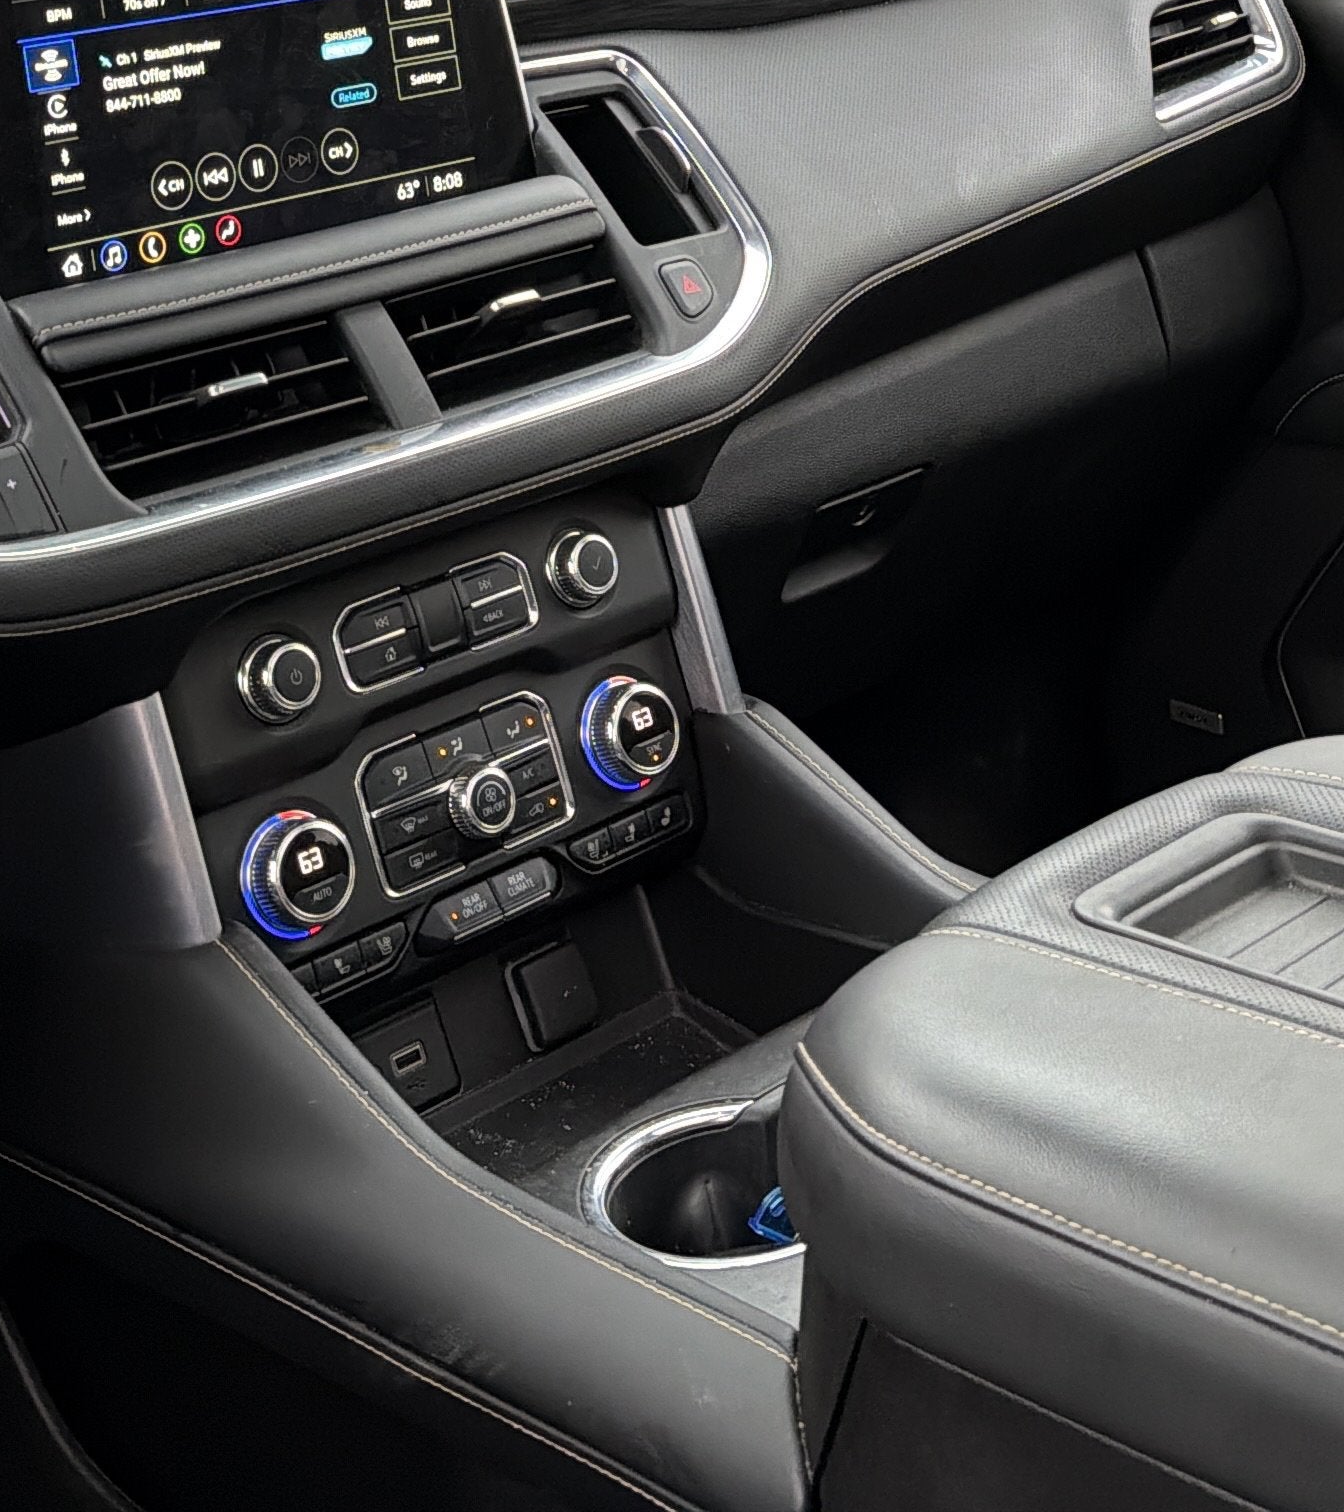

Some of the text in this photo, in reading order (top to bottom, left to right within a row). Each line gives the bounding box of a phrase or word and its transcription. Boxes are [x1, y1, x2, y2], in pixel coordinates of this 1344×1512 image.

[46, 7, 73, 23] BPM
[406, 34, 440, 49] Browse
[116, 53, 130, 67] Ch
[186, 39, 222, 56] Preview
[102, 61, 206, 92] Great Offer Now!
[409, 71, 447, 87] Settings
[338, 88, 370, 103] Related
[44, 122, 77, 137] iPhone
[328, 146, 344, 159] CH
[50, 172, 85, 187] iPhone
[167, 178, 185, 192] CH
[432, 171, 463, 193] 8:08
[397, 179, 421, 200] 63°
[57, 212, 83, 226] More
[630, 706, 654, 731] 63
[522, 767, 535, 780] A/C
[481, 799, 507, 818] ON/OFF
[297, 846, 324, 875] 63
[507, 871, 526, 886] REAR
[311, 886, 333, 904] AUTO
[507, 879, 536, 897] CLIMATE
[462, 892, 481, 907] REAR
[462, 899, 489, 919] ON/OFF
